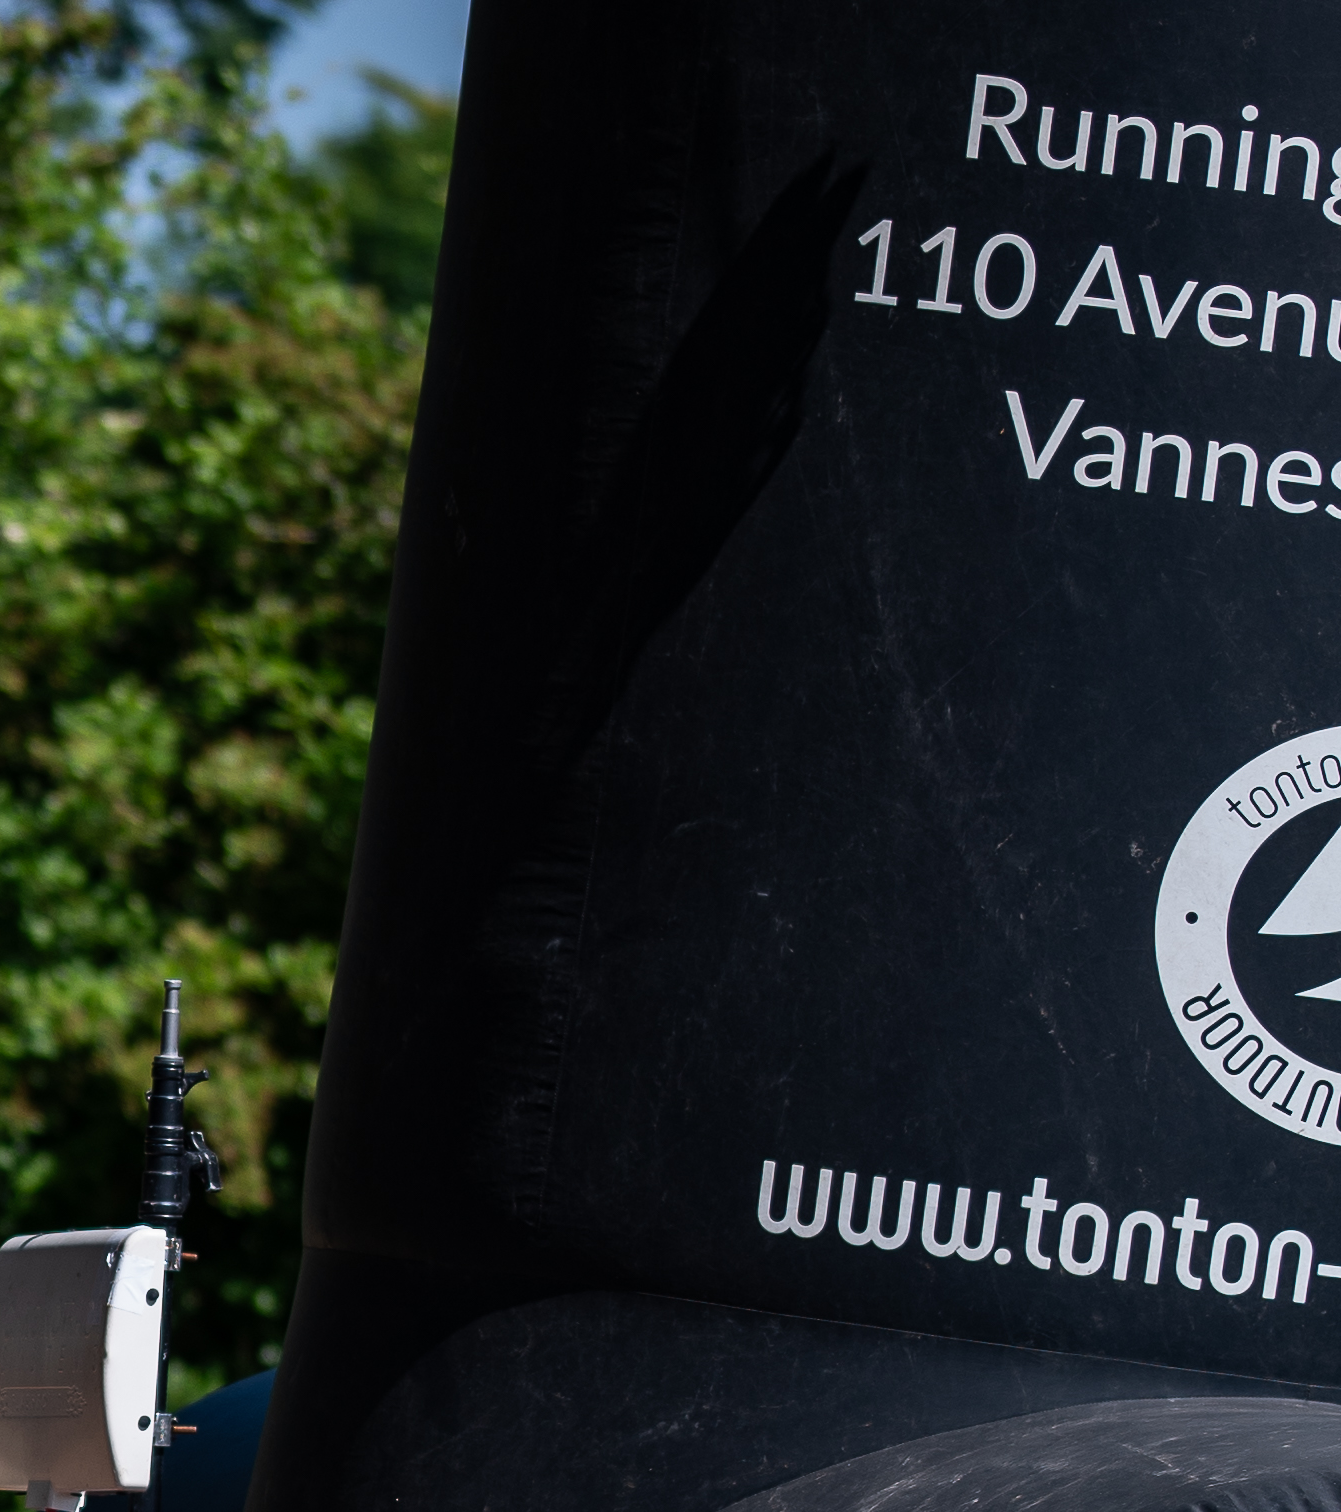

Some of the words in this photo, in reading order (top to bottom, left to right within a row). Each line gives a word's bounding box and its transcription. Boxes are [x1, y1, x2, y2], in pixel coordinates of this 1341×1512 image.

[966, 74, 1341, 226] Runnin
[854, 219, 1037, 320] 110
[1055, 245, 1341, 363] Aven
[1005, 390, 1341, 520] Vanne
[1181, 982, 1341, 1133] UTDOOR
